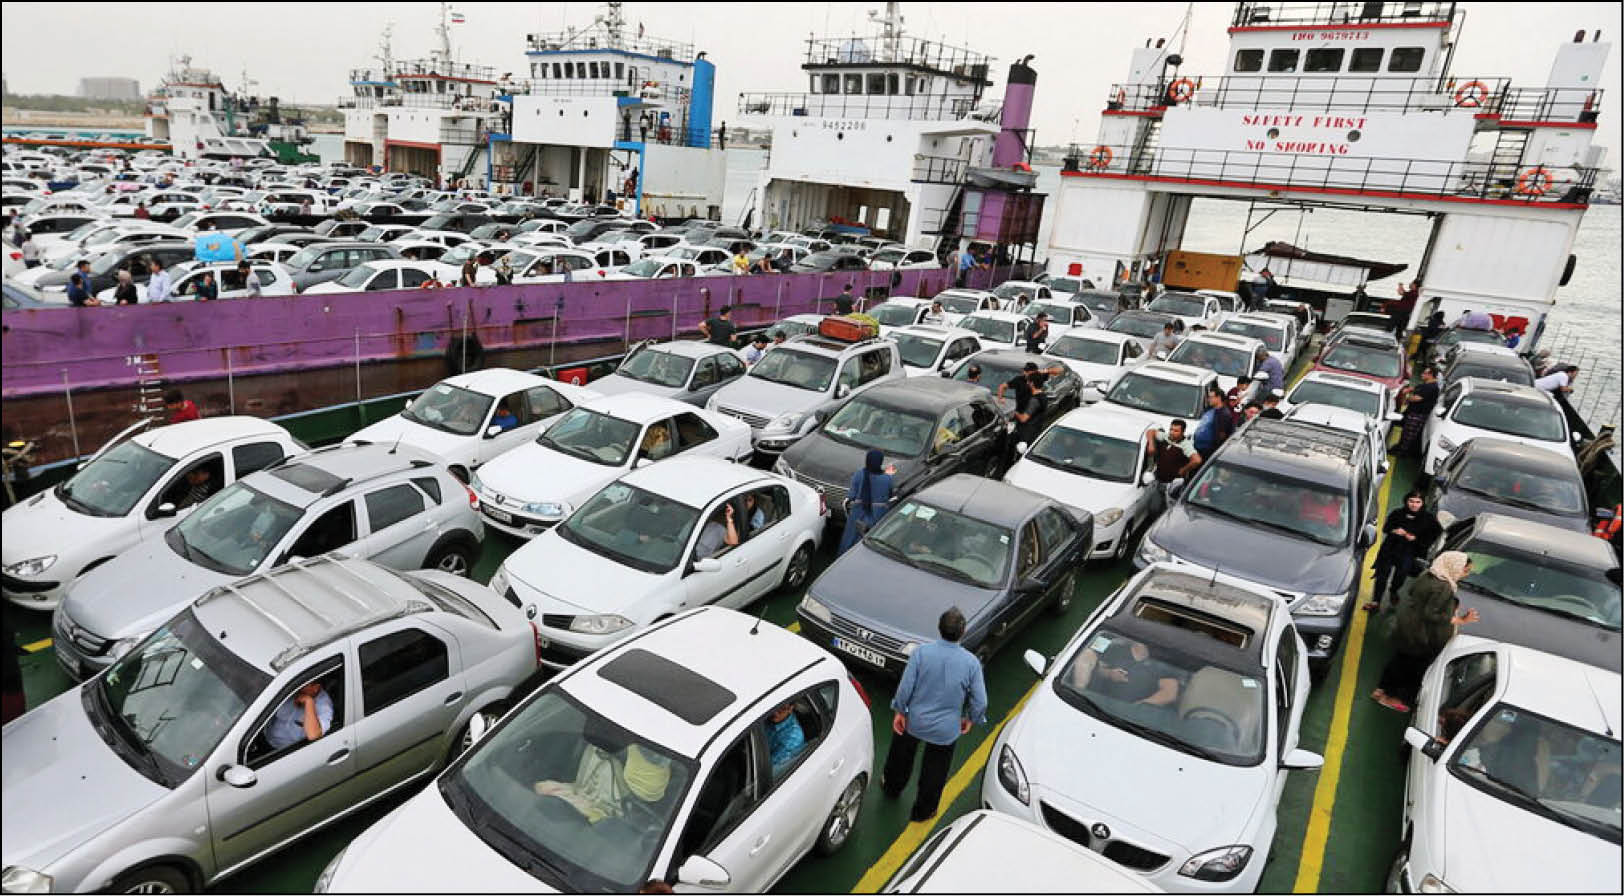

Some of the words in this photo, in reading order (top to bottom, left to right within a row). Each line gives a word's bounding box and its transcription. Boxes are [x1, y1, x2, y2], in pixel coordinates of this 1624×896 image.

[1242, 115, 1303, 126] SAFETY
[1313, 116, 1368, 129] FIRST
[1246, 139, 1266, 150] NO
[1275, 141, 1350, 154] SMOKING
